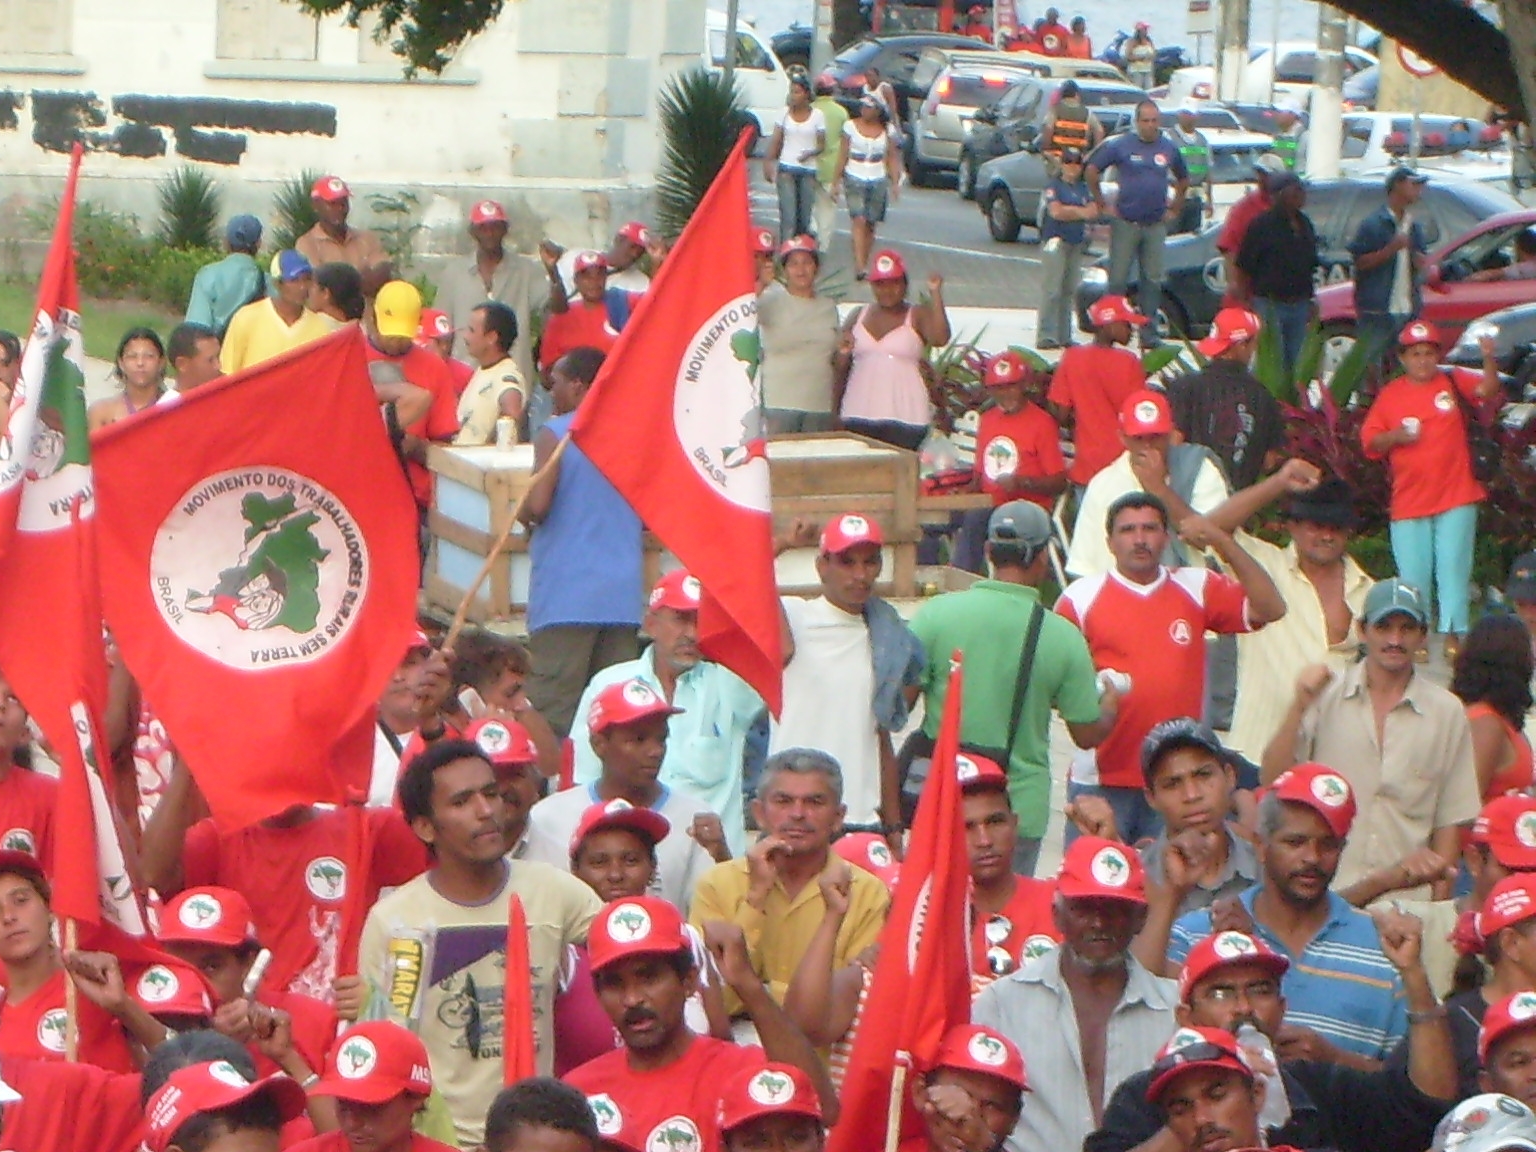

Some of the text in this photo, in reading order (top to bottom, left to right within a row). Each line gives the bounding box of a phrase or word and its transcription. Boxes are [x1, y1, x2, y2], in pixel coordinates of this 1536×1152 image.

[685, 308, 740, 383] MOVIMENTO
[693, 447, 728, 488] BRASIL
[182, 472, 364, 664] MOVIMENTO DOS TRABALHADORES RURAIS SEM TERRA
[157, 576, 185, 625] BRASIL
